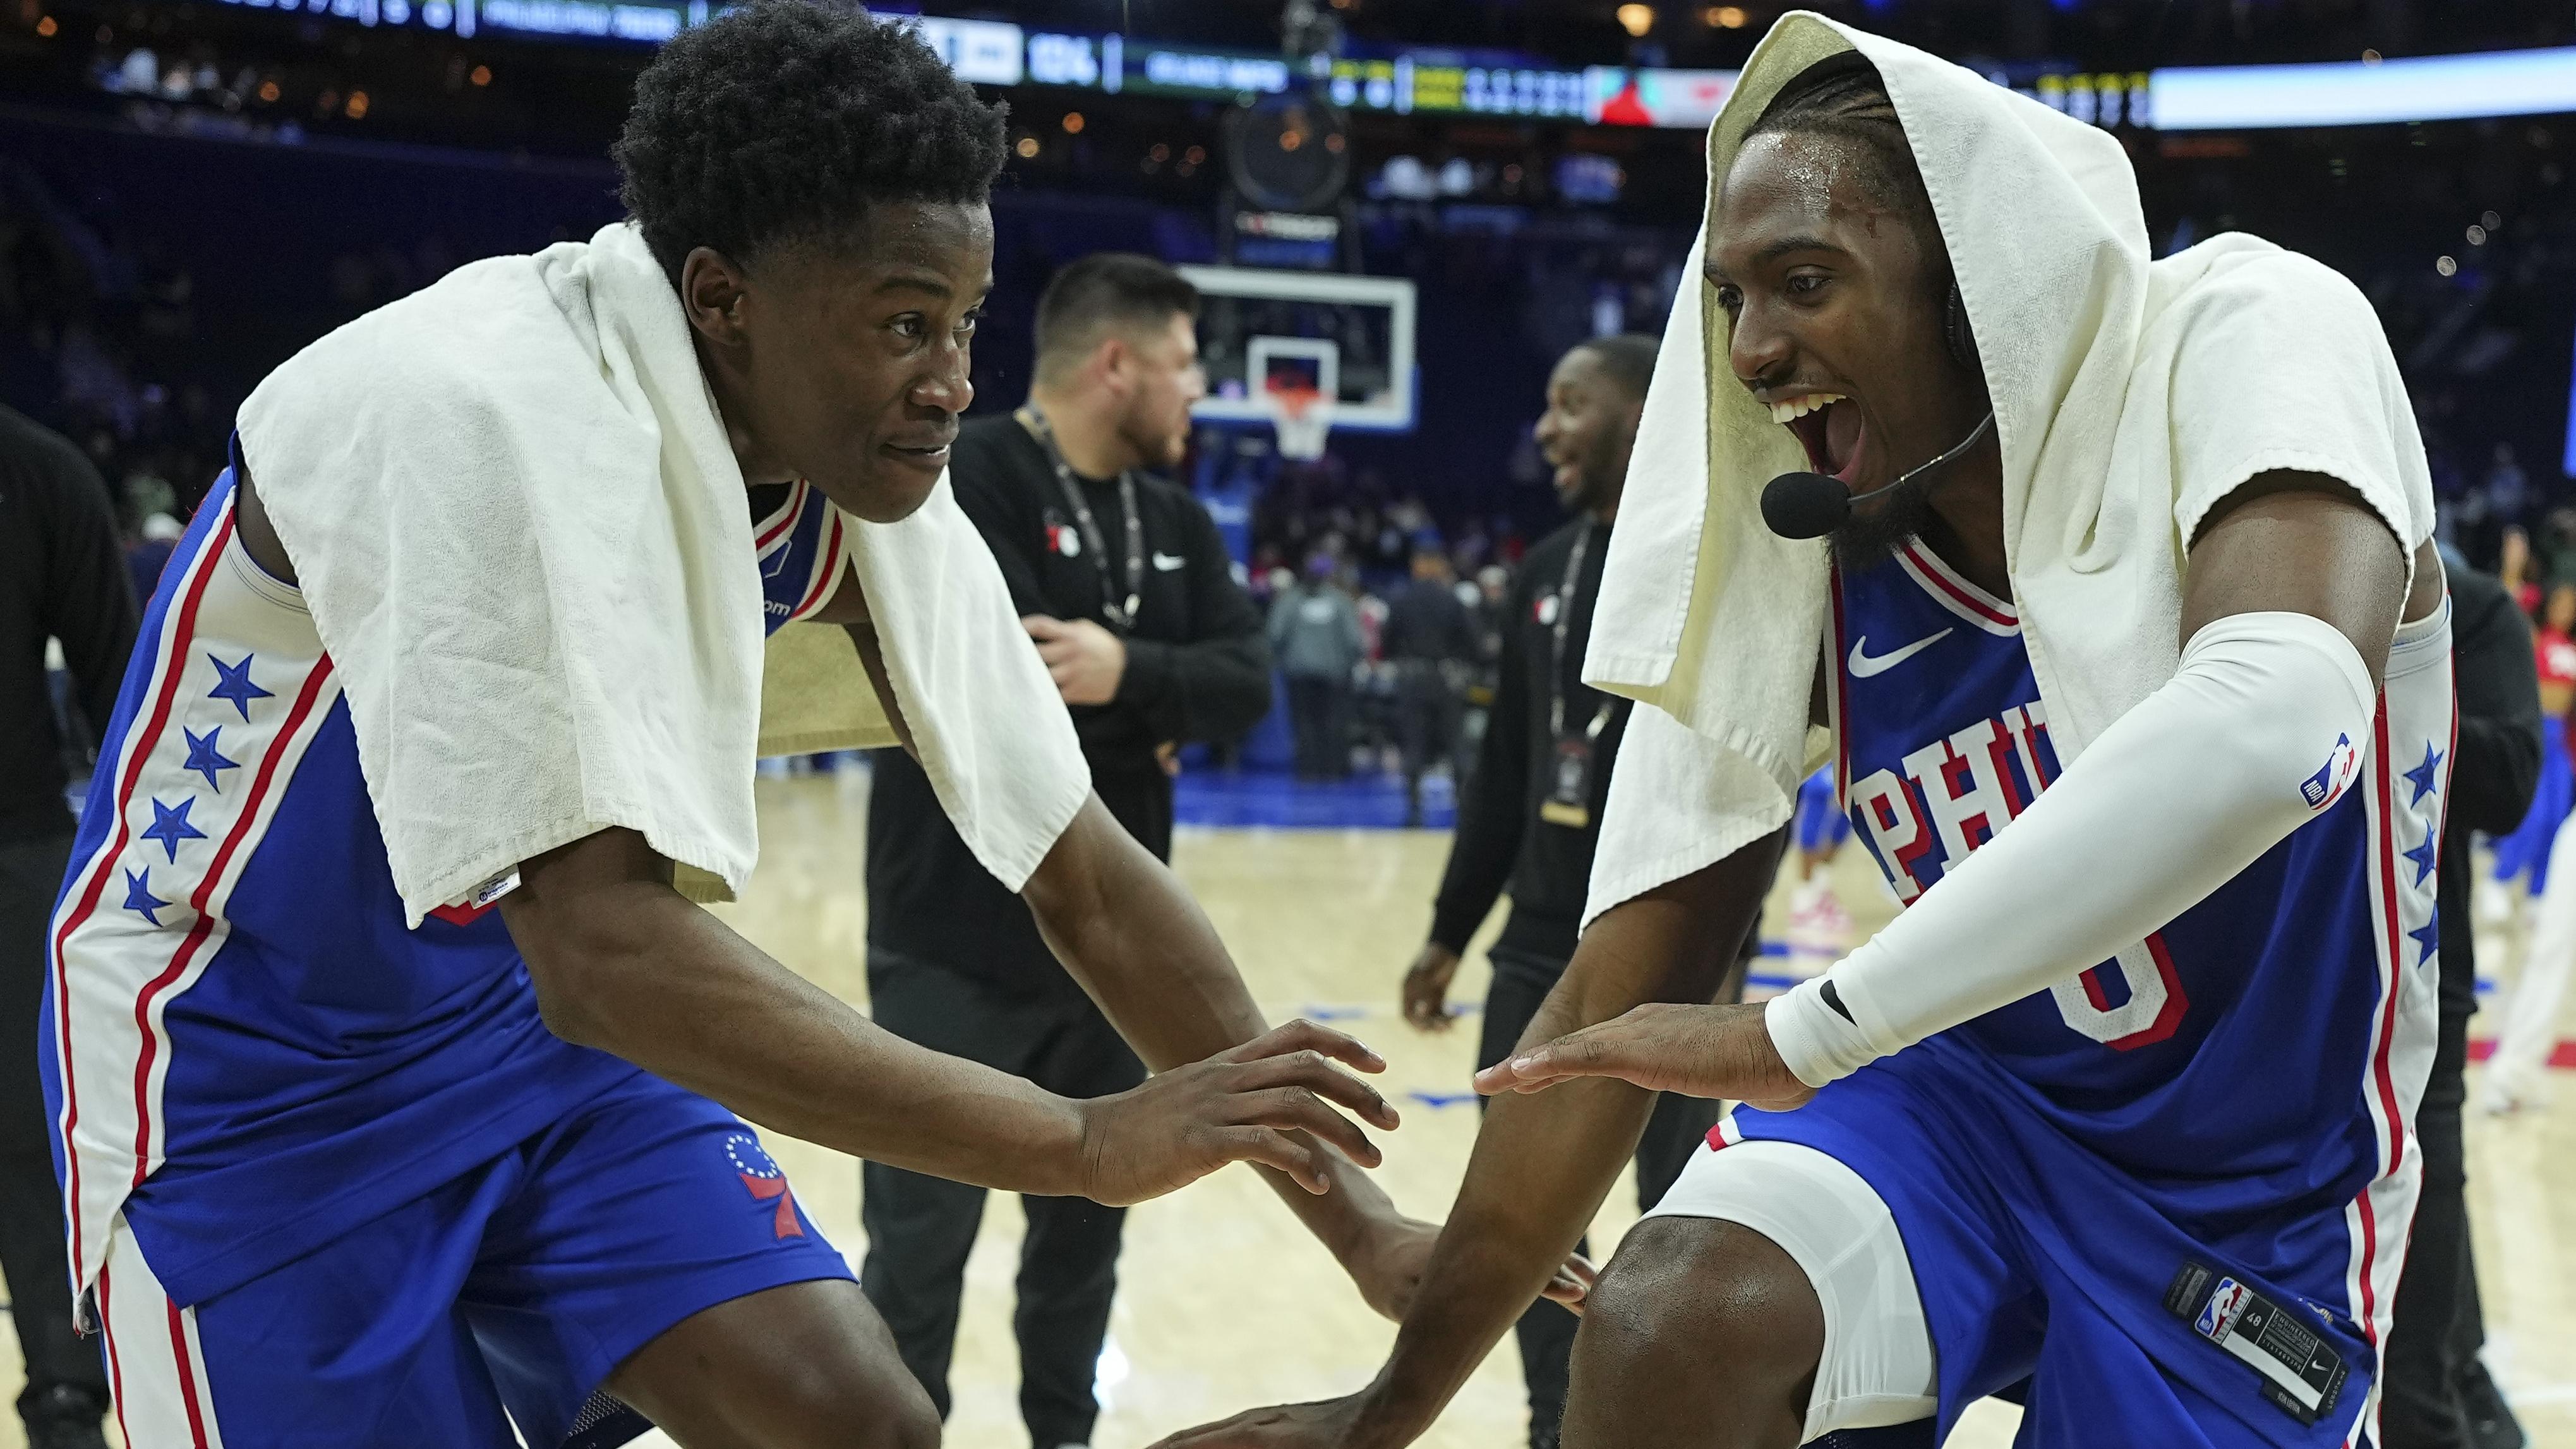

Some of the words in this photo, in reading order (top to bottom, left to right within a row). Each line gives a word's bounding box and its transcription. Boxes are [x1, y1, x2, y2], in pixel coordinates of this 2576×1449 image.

[2303, 779, 2326, 802] NBA
[2199, 1318, 2213, 1331] NBA
[2246, 1313, 2262, 1327] 48
